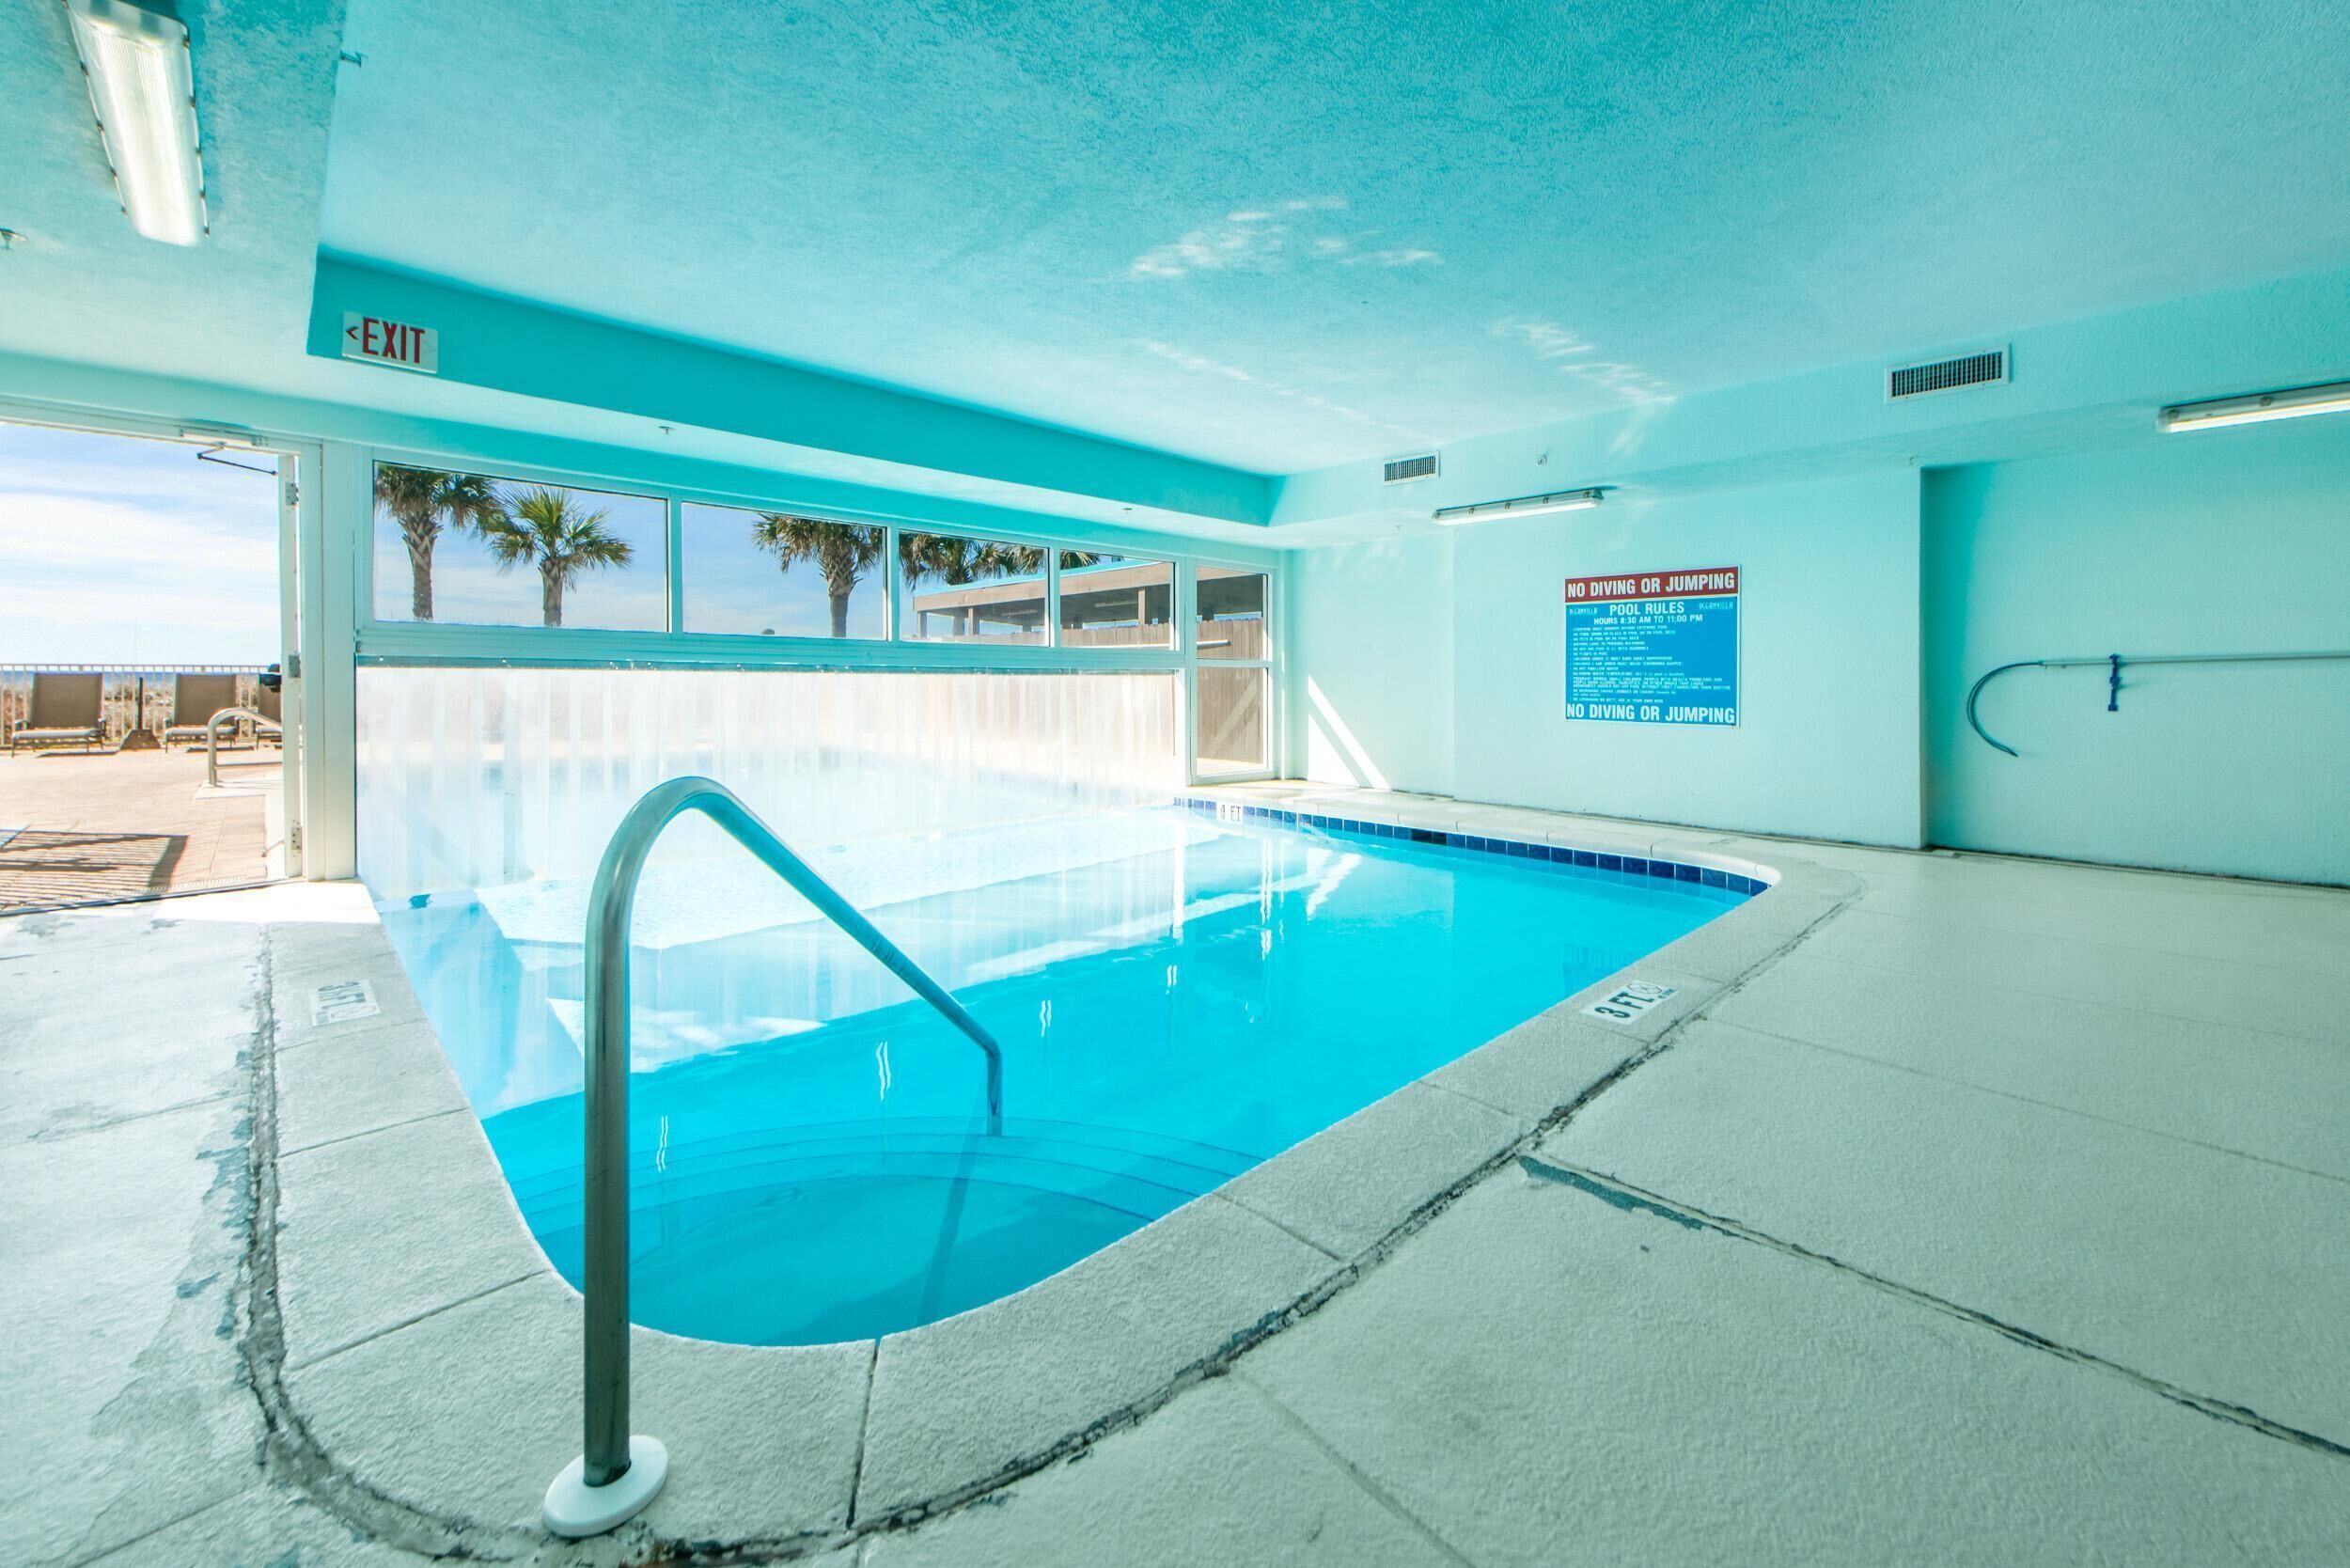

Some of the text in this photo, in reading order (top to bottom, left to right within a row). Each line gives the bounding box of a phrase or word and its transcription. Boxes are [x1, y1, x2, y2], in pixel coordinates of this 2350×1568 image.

[362, 316, 425, 364] EXIT
[1567, 572, 1735, 598] NO DIVING OR JUMPING
[1609, 601, 1684, 616] POOL RULES
[1593, 617, 1618, 625] HOURS
[1620, 616, 1637, 624] 8:30
[1653, 615, 1664, 623] TO
[1689, 614, 1703, 622] PM
[1566, 703, 1735, 724] NO DIVING OR JUMPING
[1607, 991, 1655, 1010] FT
[1594, 1006, 1631, 1019] 3
